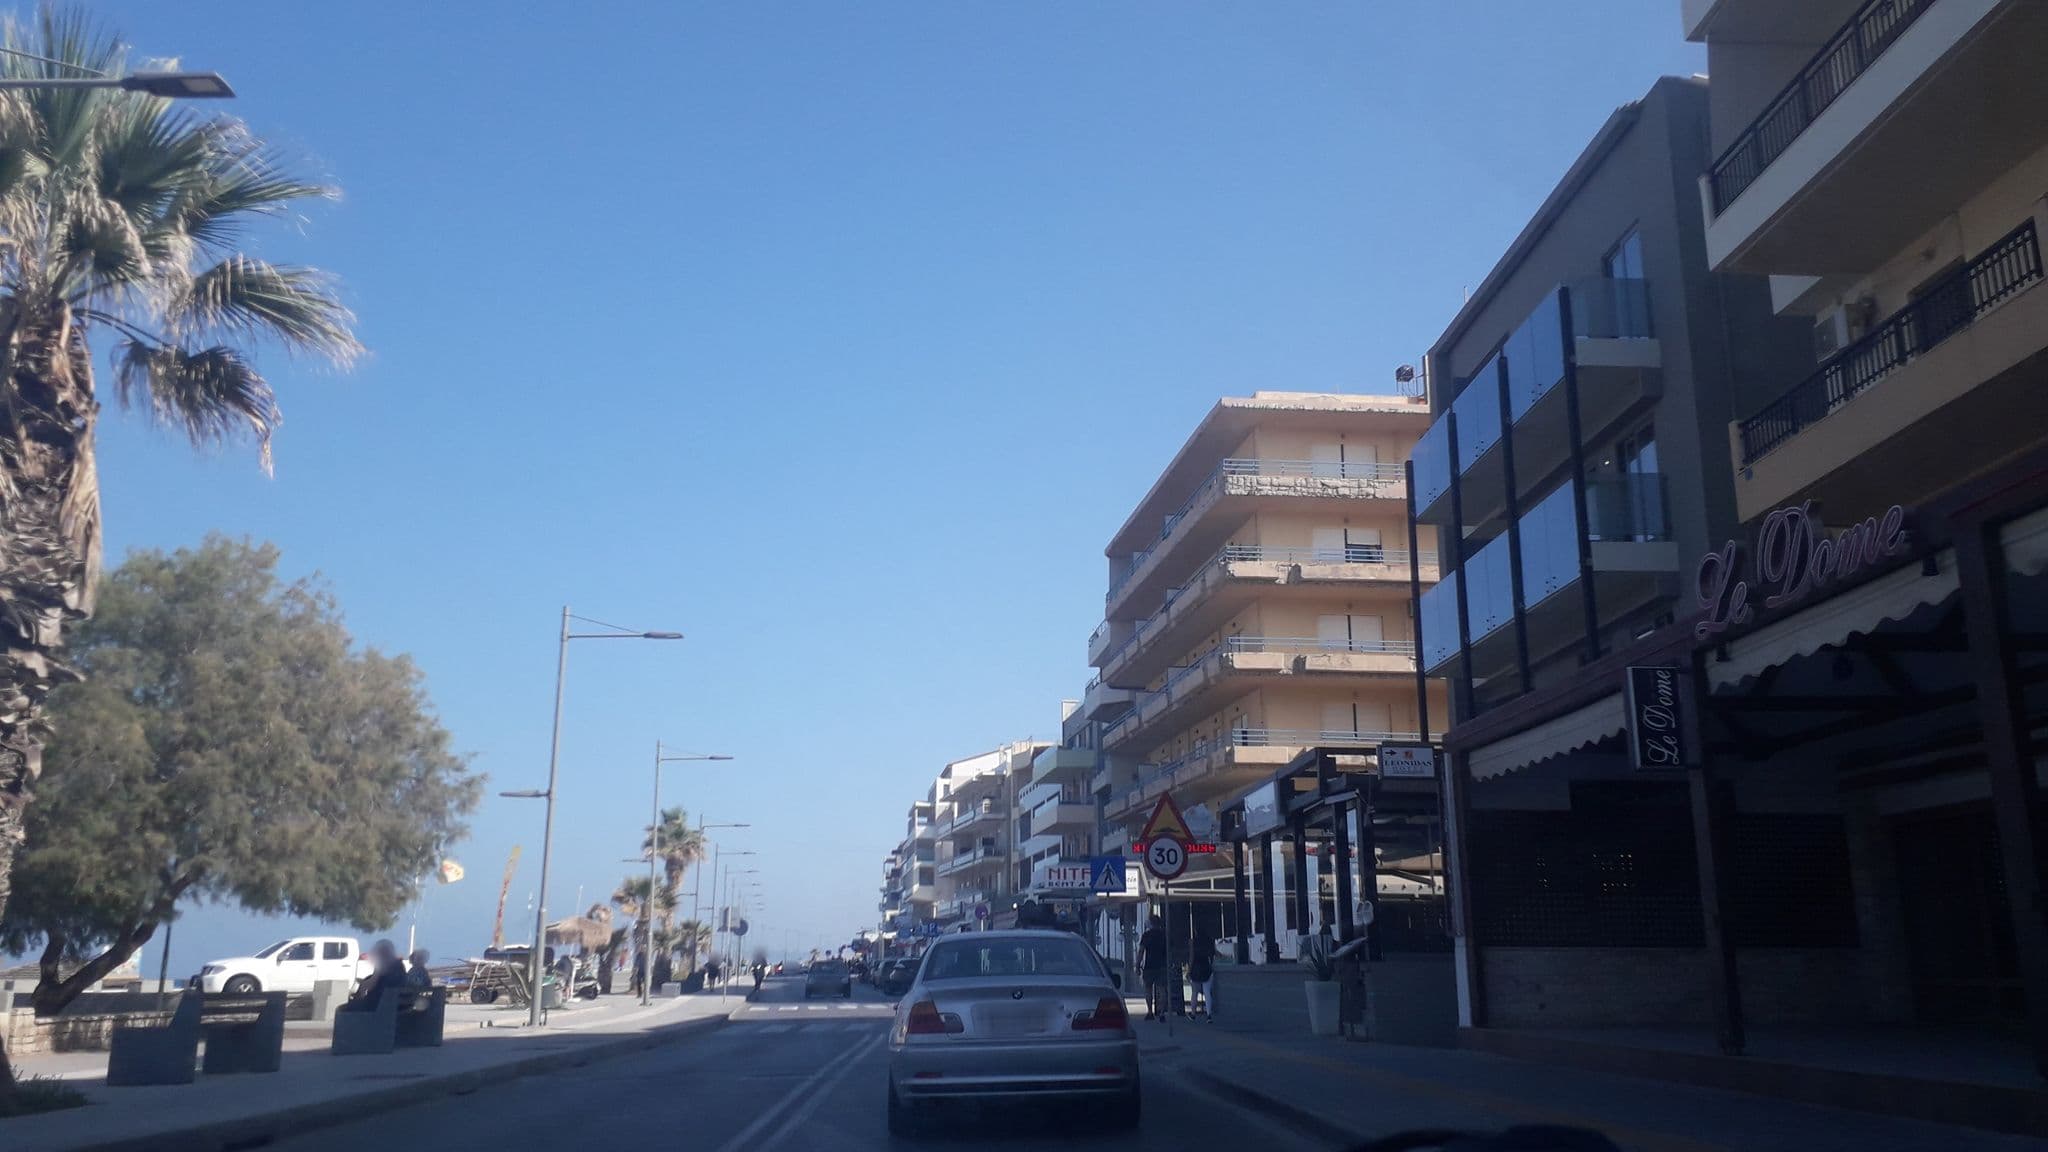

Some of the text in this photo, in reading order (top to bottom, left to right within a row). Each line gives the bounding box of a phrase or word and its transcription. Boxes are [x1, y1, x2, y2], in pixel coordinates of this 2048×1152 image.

[1695, 499, 1905, 639] Le Dome
[1641, 669, 1680, 765] Le Dome
[1155, 848, 1178, 865] 30
